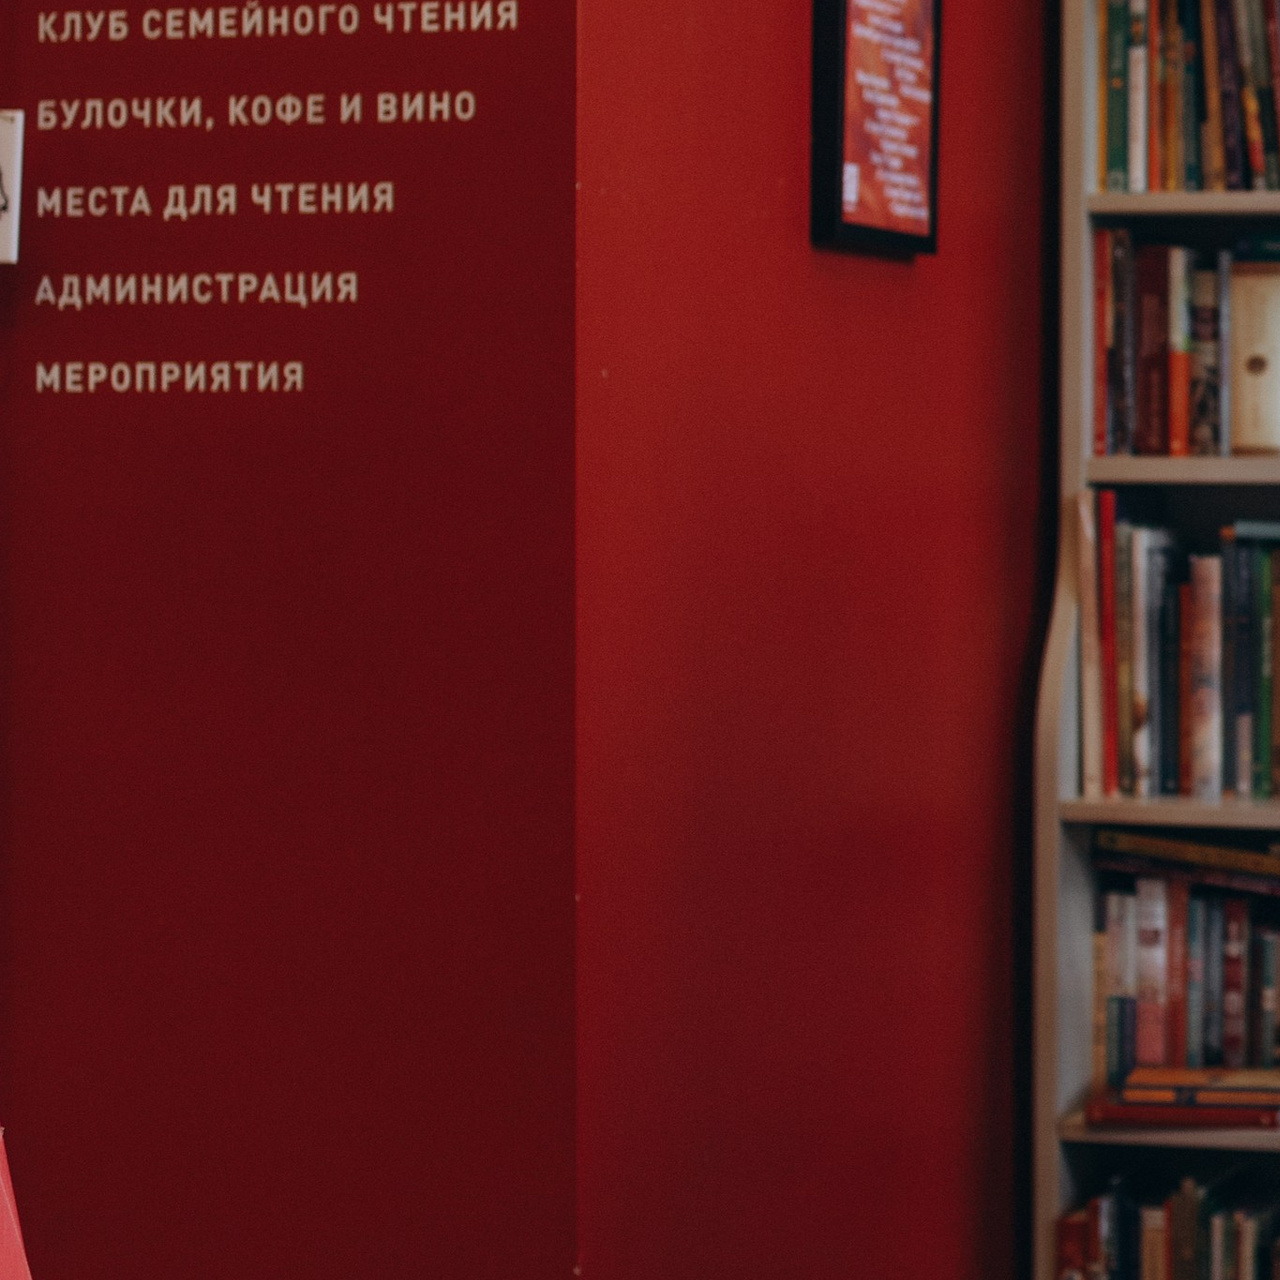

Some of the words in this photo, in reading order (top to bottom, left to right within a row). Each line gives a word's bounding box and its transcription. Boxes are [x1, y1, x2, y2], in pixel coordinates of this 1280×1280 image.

[39, 10, 130, 43] КЛУБ
[143, 1, 360, 40] СЕМЕЙНОГО
[373, 0, 519, 34] ЧТЕНИЯ
[37, 98, 215, 131] БУЛОЧКИ,
[228, 94, 326, 126] КОФЕ
[340, 93, 363, 124] И
[377, 90, 477, 124] ВИНО
[37, 186, 152, 218] МЕСТА
[163, 184, 238, 222] ДЛЯ
[251, 181, 395, 215] ЧТЕНИЯ
[35, 272, 359, 312] АДМИНИСТРАЦИЯ
[36, 361, 304, 394] МЕРОПРИЯТИЯ
